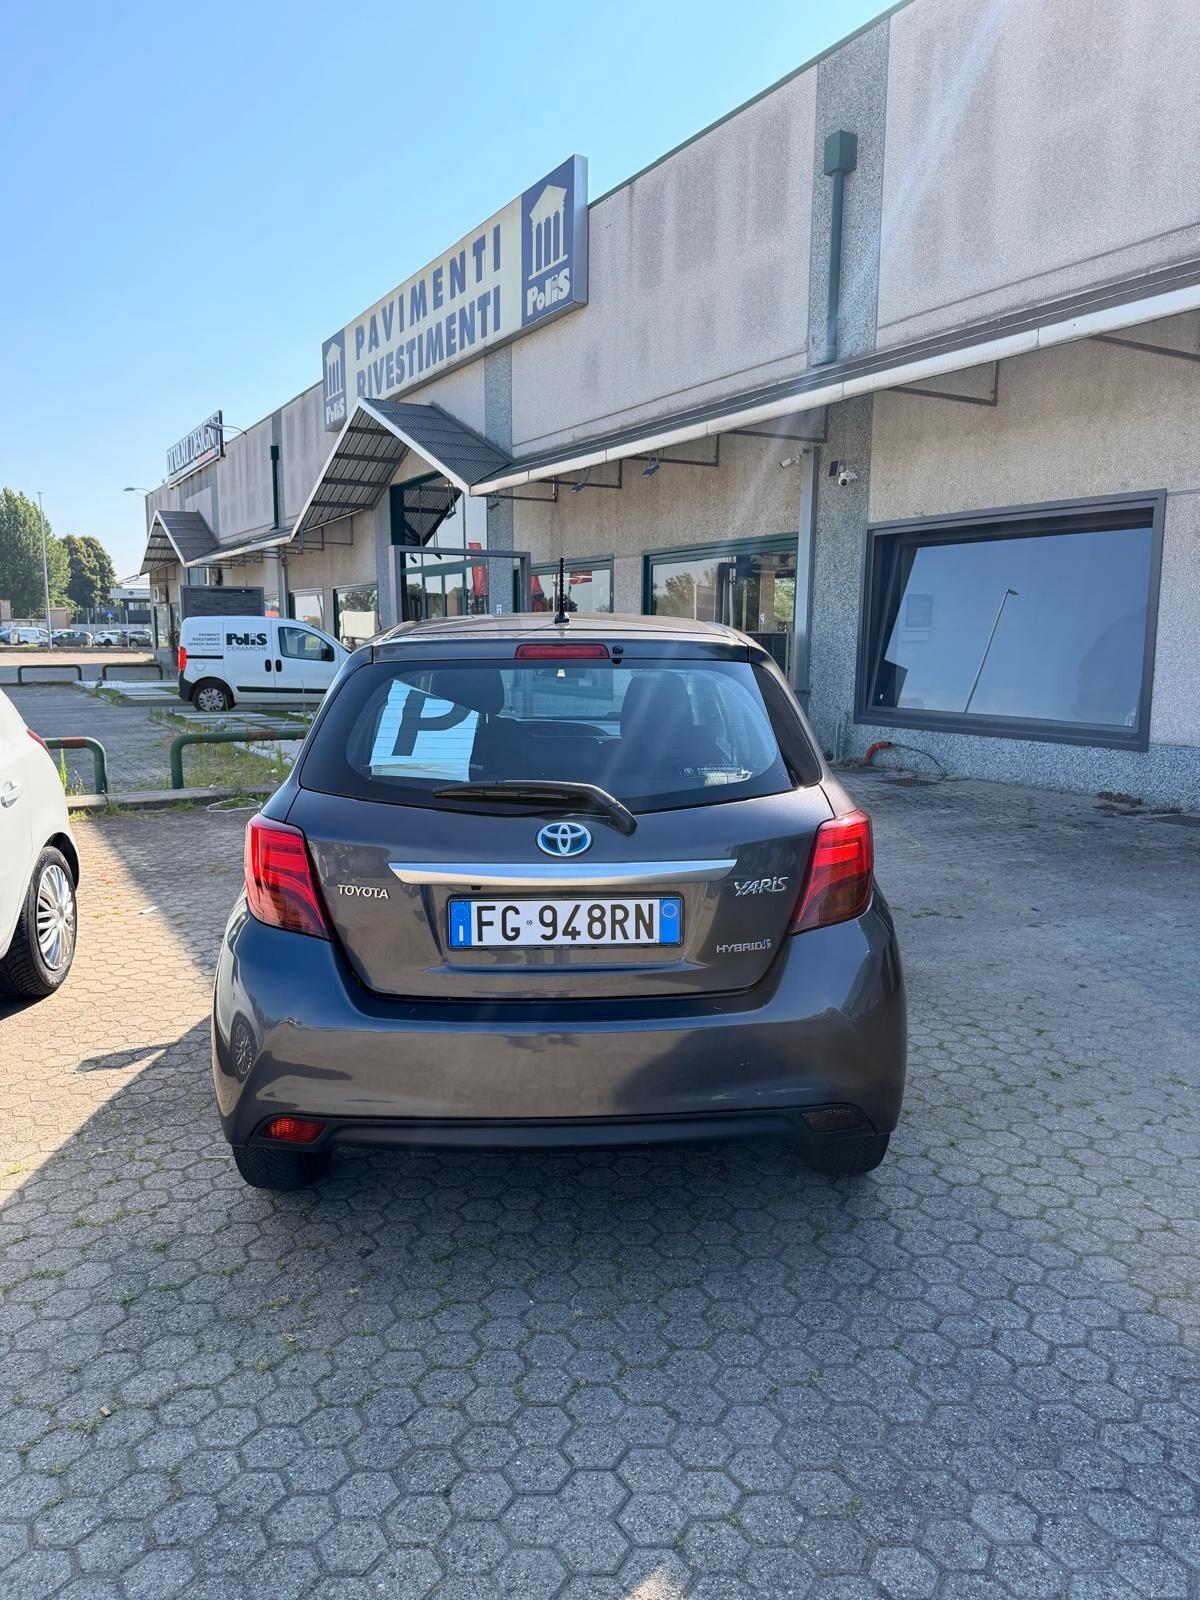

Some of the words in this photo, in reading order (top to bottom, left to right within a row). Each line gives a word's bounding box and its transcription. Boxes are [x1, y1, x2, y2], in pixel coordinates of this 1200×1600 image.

[355, 223, 501, 361] PAVIMENTI
[356, 284, 501, 398] RIVESTIMENTI
[390, 688, 472, 757] P
[337, 883, 390, 900] TOYOTA
[476, 904, 521, 942] FG
[538, 903, 655, 942] 948RN
